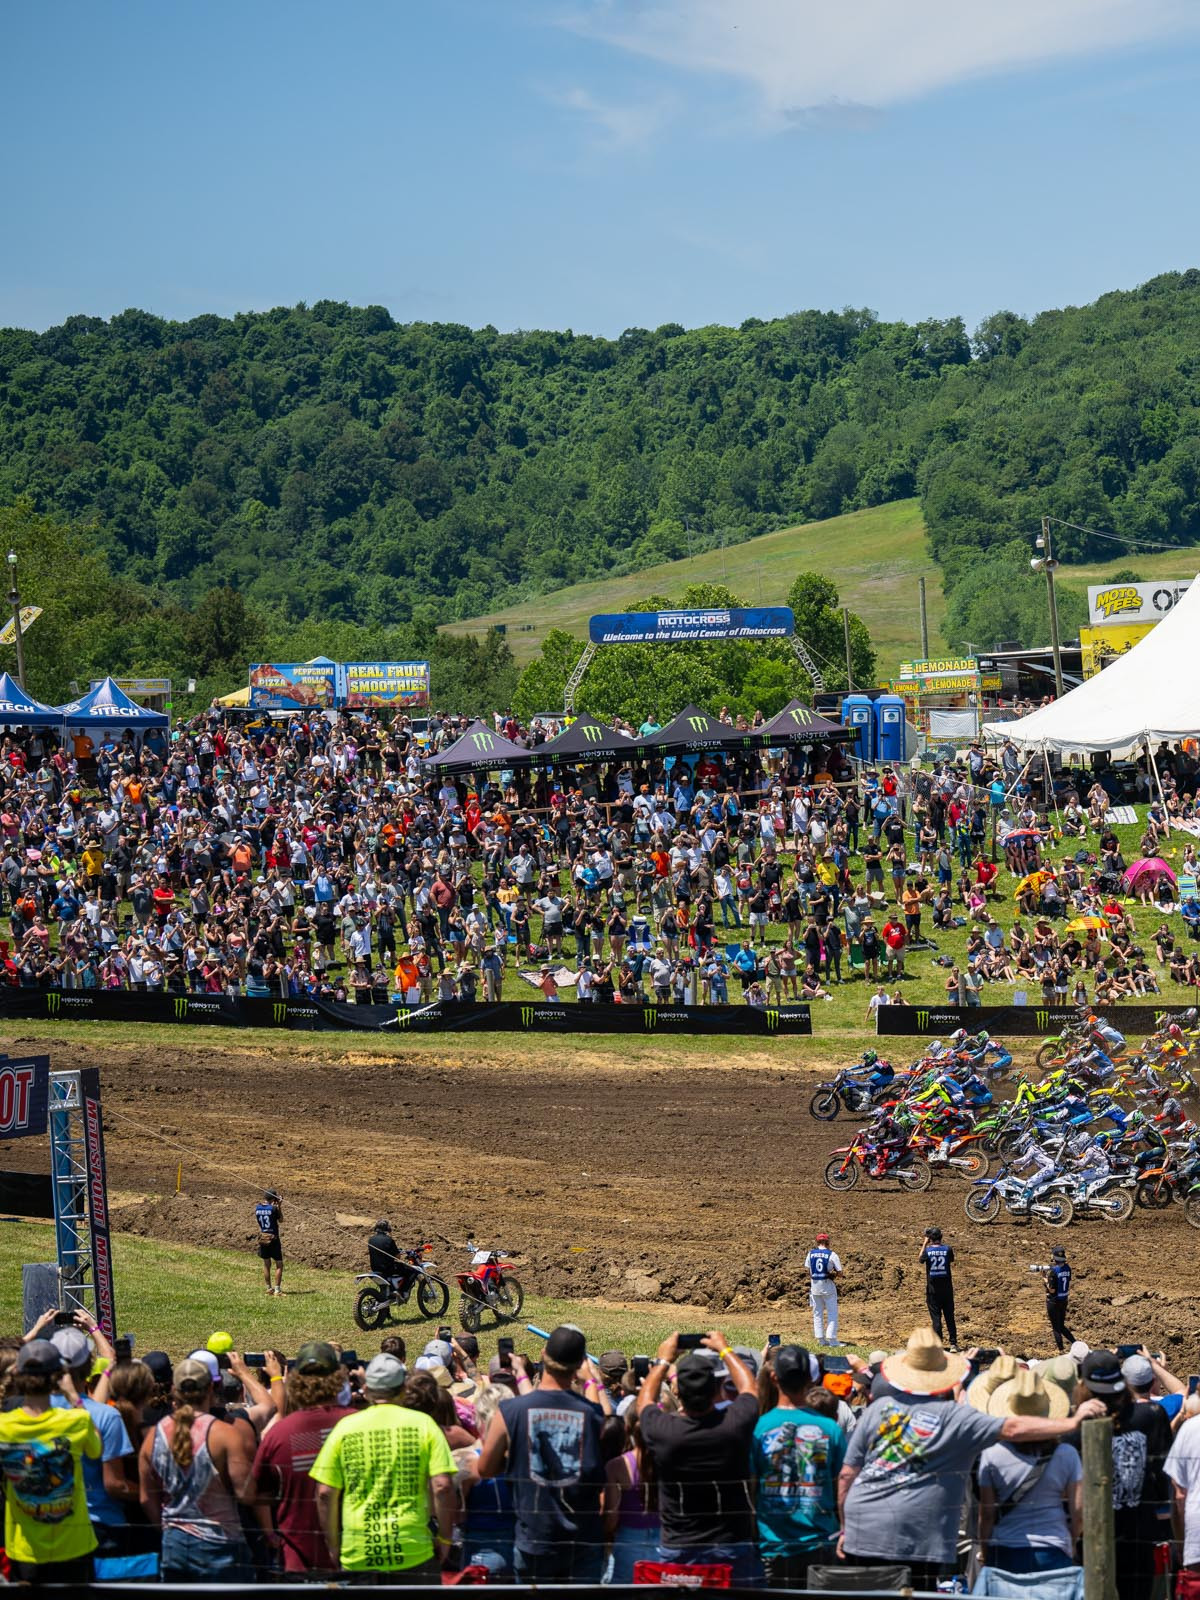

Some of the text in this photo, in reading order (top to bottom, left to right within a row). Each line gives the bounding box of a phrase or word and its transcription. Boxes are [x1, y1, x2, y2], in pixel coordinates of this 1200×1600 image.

[1097, 587, 1137, 608] MOTO
[1103, 597, 1143, 619] TEES
[657, 614, 730, 626] MOTOCROSS
[602, 632, 644, 642] Welcome
[655, 630, 671, 639] the
[671, 630, 699, 638] World
[699, 629, 728, 637] Center
[729, 627, 738, 635] of
[739, 627, 787, 635] Motocross
[293, 667, 334, 676] PEPPERONI
[349, 665, 427, 678] REAL FRUIT
[915, 659, 975, 674] LEMONADE
[258, 678, 288, 688] PIZZA
[302, 676, 326, 685] ROLLS
[931, 679, 972, 690] LEMONADE
[350, 680, 428, 693] SMOOTHIES
[89, 705, 139, 717] SITECH
[789, 731, 830, 741] MONSTER
[685, 738, 723, 749] MONSTER
[579, 749, 616, 759] MONSTER
[471, 758, 508, 767] MONSTER
[60, 996, 94, 1004] MONSTER
[188, 1001, 220, 1010] MONSTER
[286, 1007, 319, 1015] MONSTER
[534, 1010, 566, 1018] MONSTER
[779, 1012, 811, 1020] MONSTER
[929, 1014, 960, 1022] MONSTER
[258, 1215, 270, 1229] 13
[815, 1258, 823, 1272] 6
[930, 1256, 946, 1271] 22
[365, 1501, 399, 1511] 2014
[364, 1511, 400, 1522] 2015
[364, 1522, 399, 1533] 2016
[365, 1533, 400, 1544] 2017
[365, 1544, 402, 1556] 2018
[365, 1555, 405, 1567] 2019
